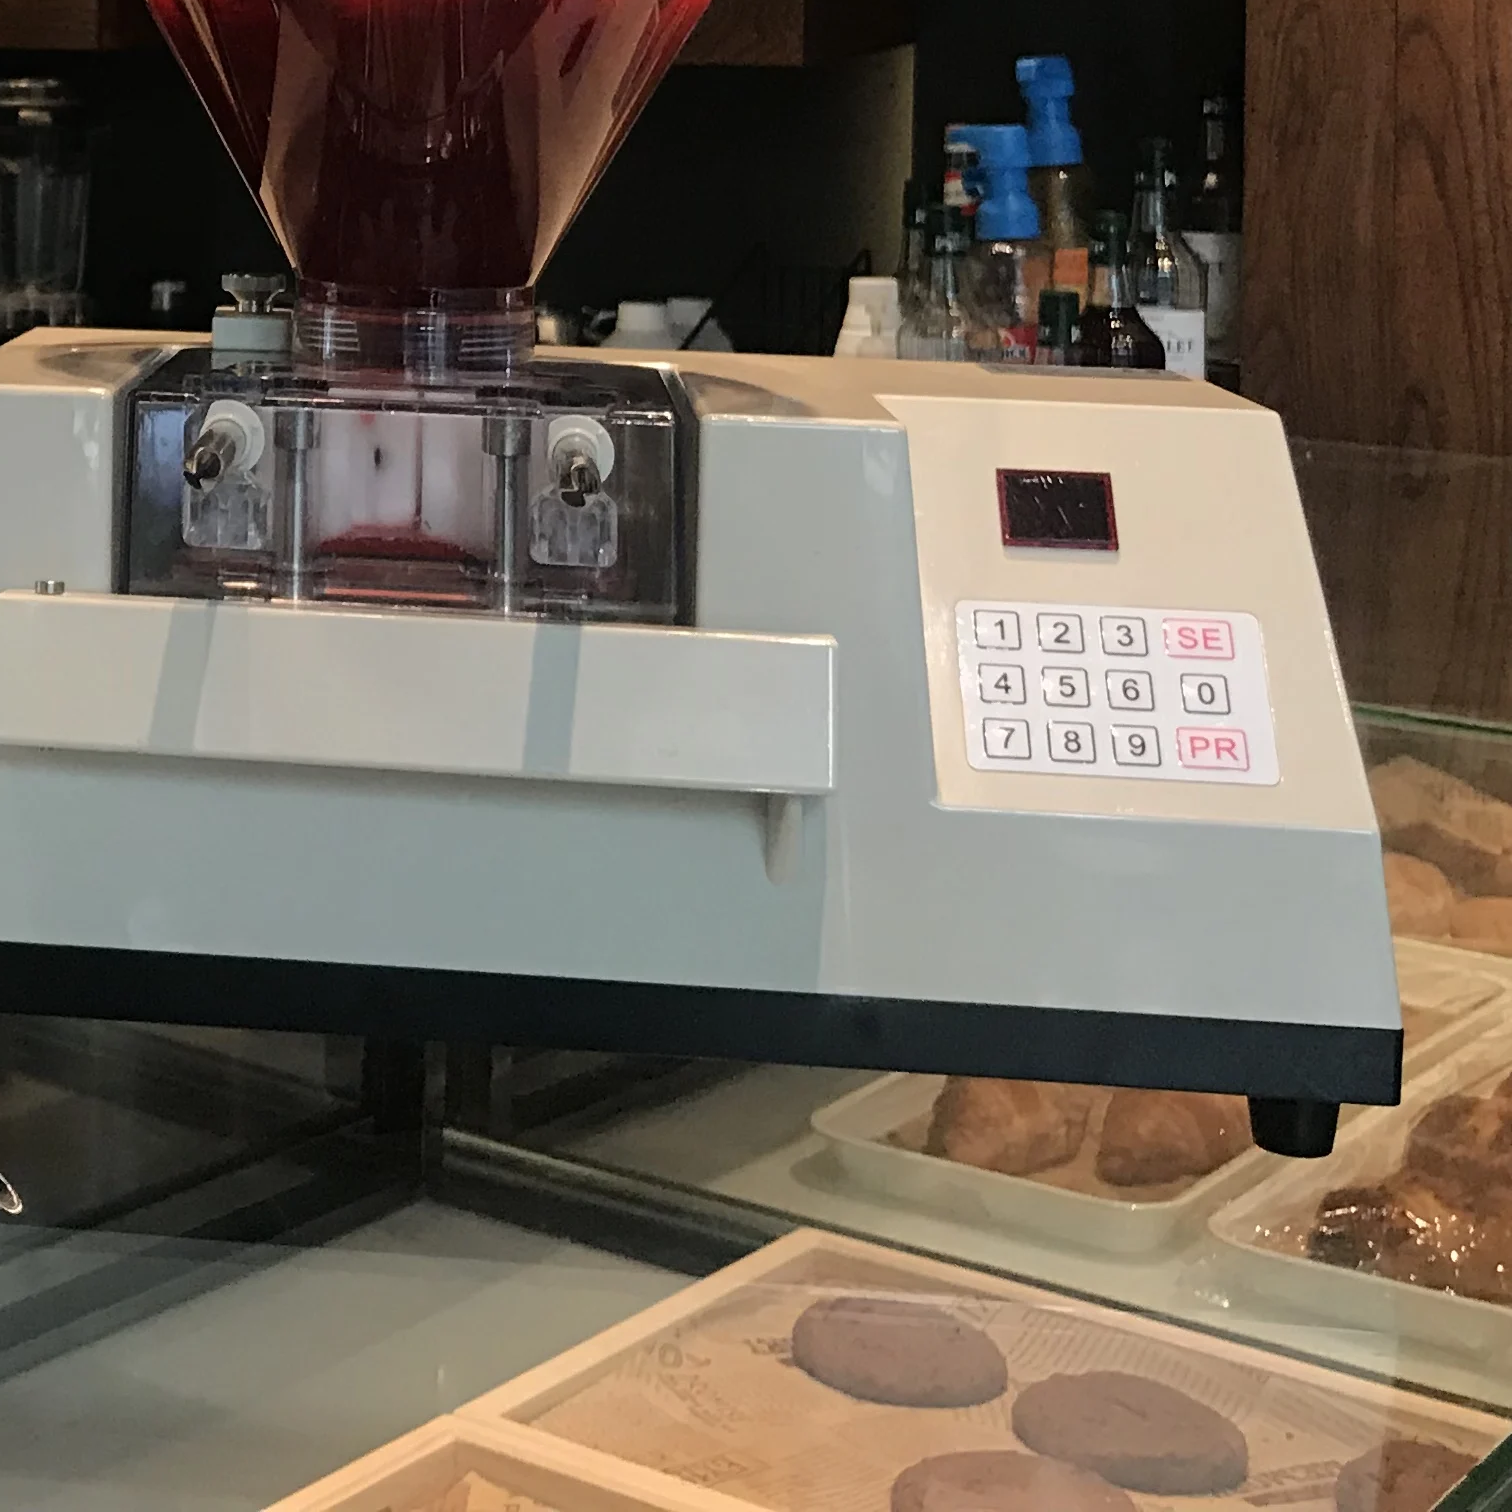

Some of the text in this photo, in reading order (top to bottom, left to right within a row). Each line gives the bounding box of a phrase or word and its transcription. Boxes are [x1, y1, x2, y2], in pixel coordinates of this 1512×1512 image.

[993, 618, 1224, 651] 1 2 3 SE
[994, 672, 1215, 705] 4 5 6 0
[999, 727, 1240, 762] 7 8 9 PR
